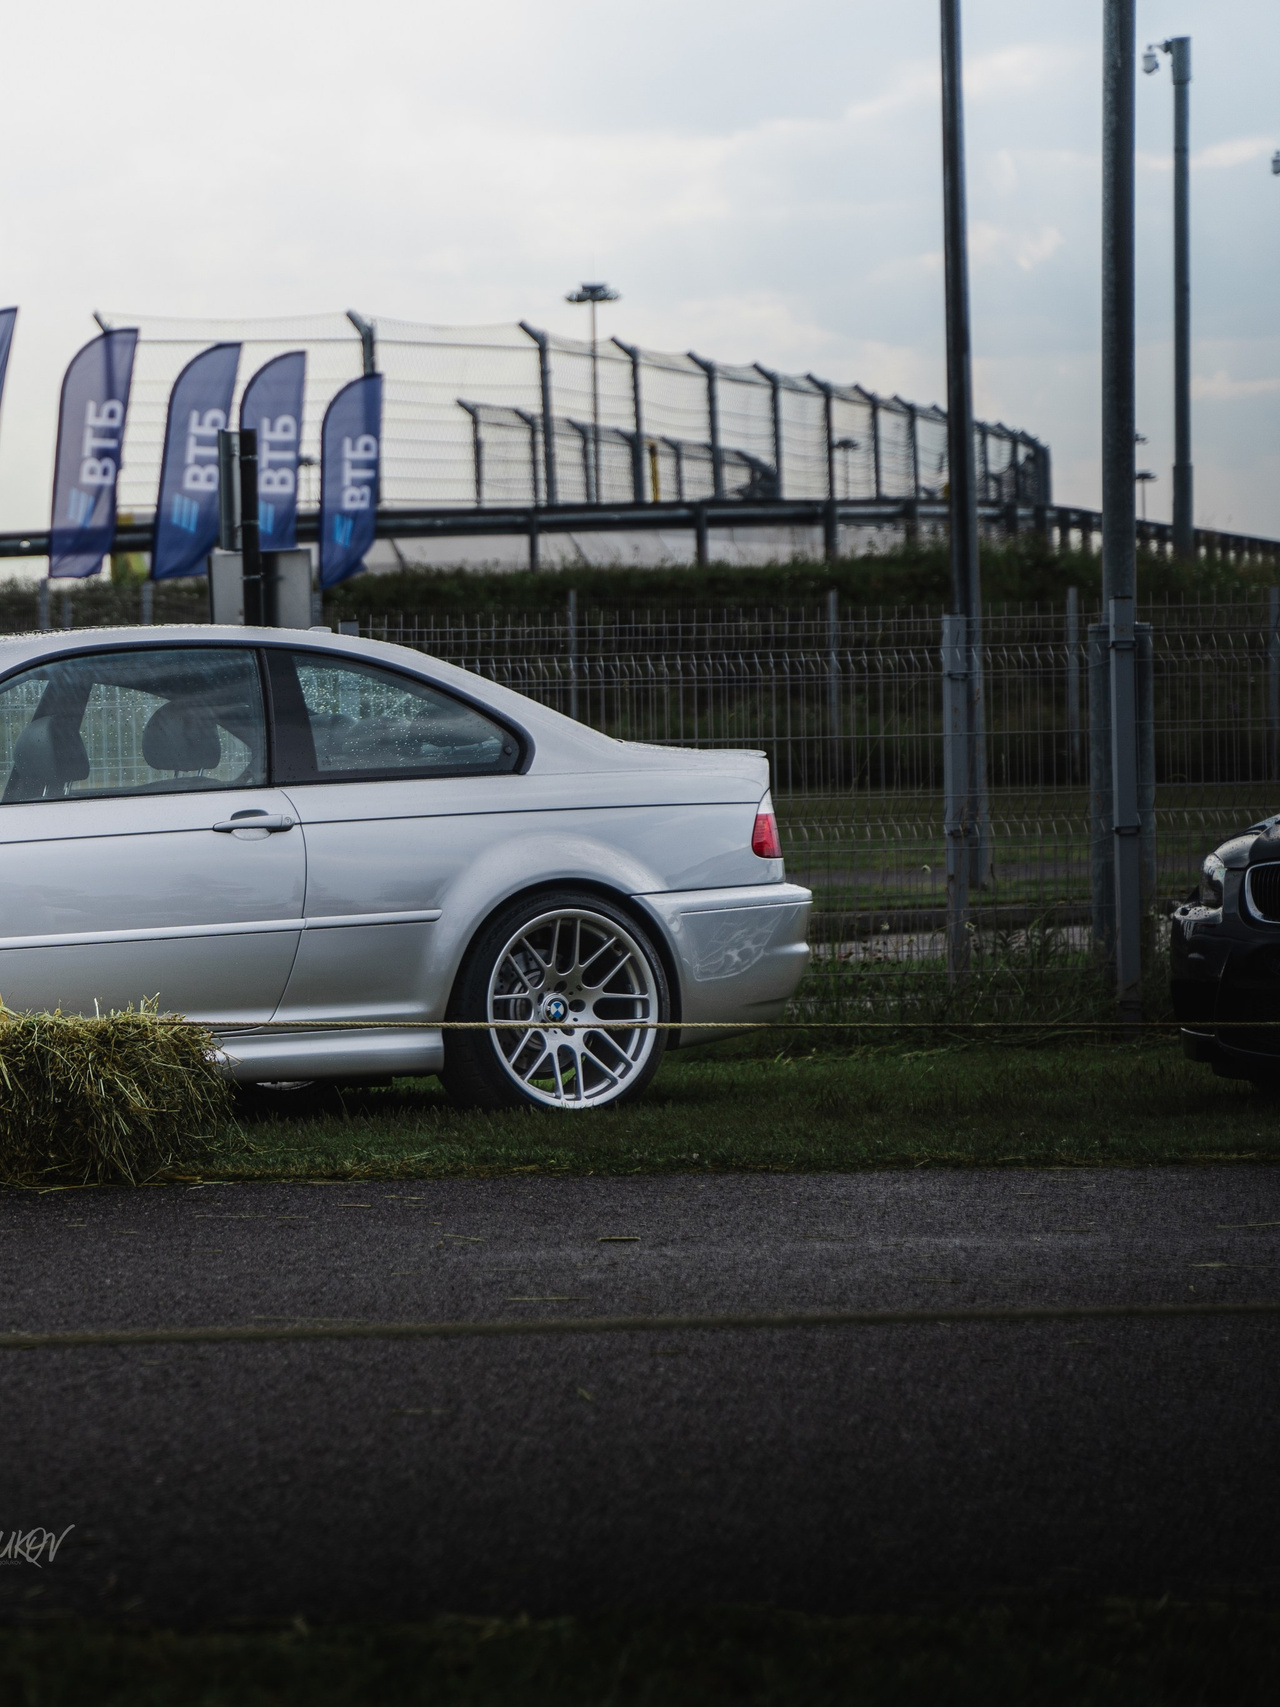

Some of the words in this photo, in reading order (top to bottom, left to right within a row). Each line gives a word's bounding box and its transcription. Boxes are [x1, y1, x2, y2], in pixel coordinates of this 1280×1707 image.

[81, 398, 124, 486] ВТБ
[184, 407, 227, 492] ВТБ
[258, 413, 297, 495] ВТБ
[342, 433, 378, 511] ВТБ
